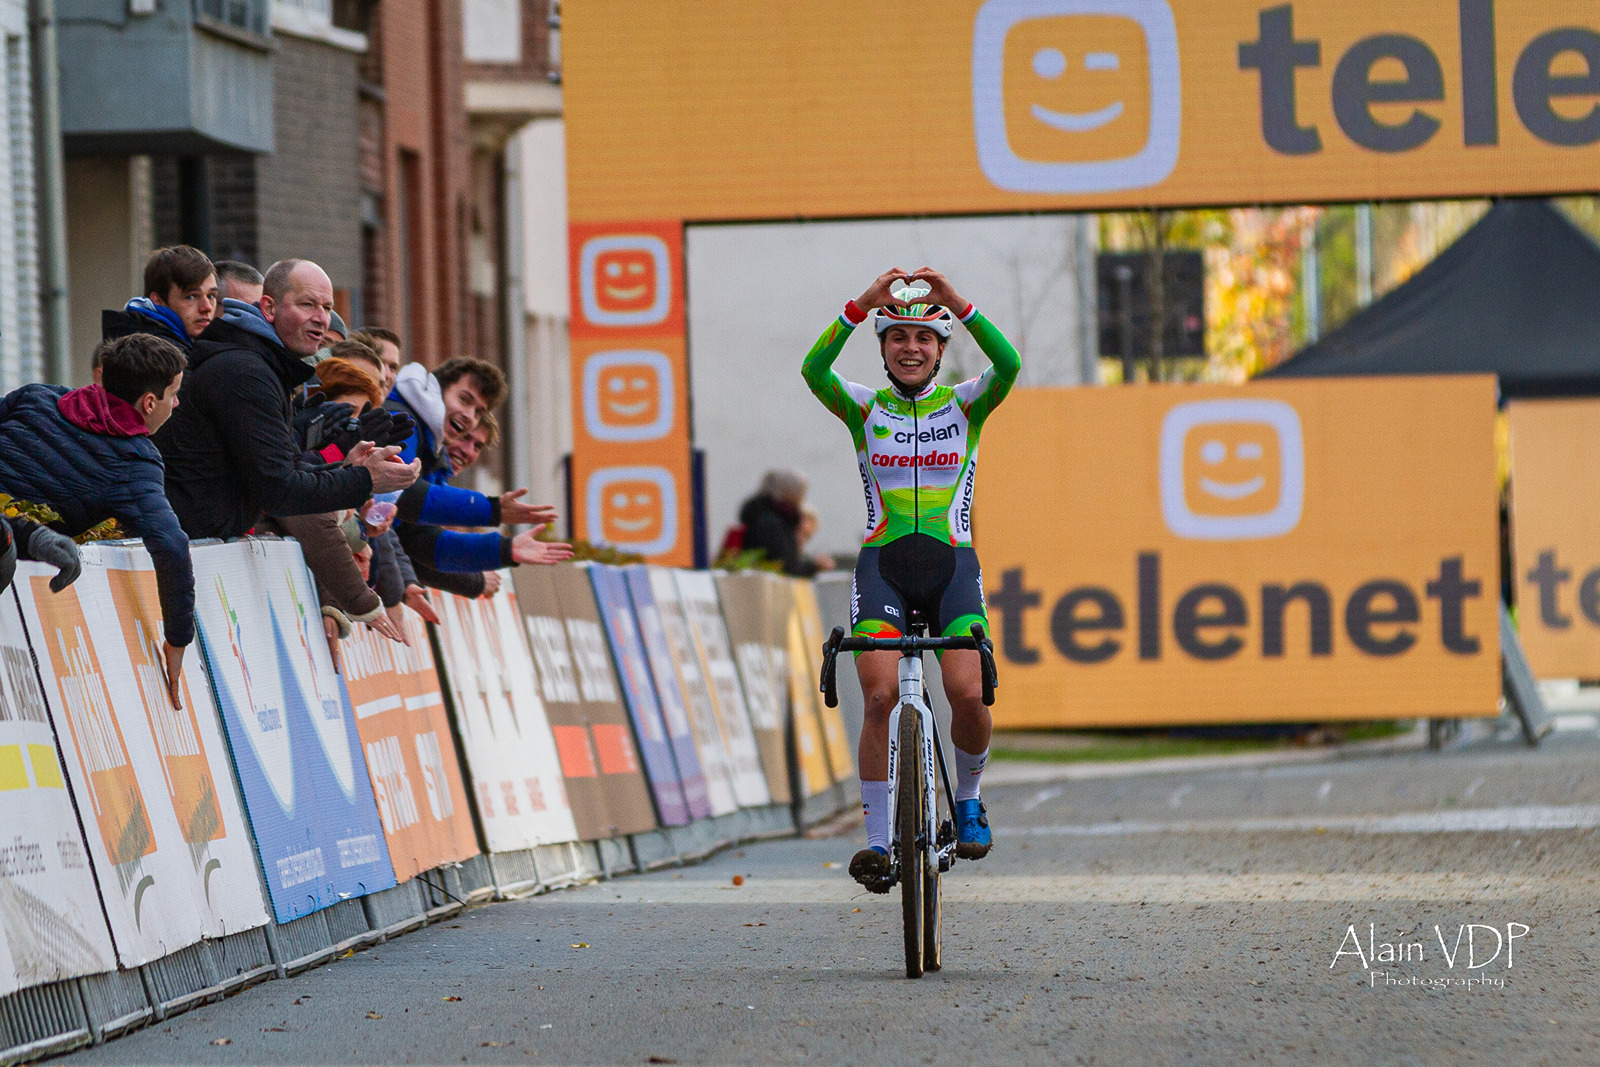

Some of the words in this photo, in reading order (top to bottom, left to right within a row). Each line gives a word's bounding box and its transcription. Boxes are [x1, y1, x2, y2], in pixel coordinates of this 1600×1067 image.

[1237, 0, 1600, 156] tele
[894, 423, 960, 444] crelan
[860, 462, 876, 531] FRISTADS
[960, 460, 977, 533] FRISTADS
[988, 551, 1482, 666] telenet
